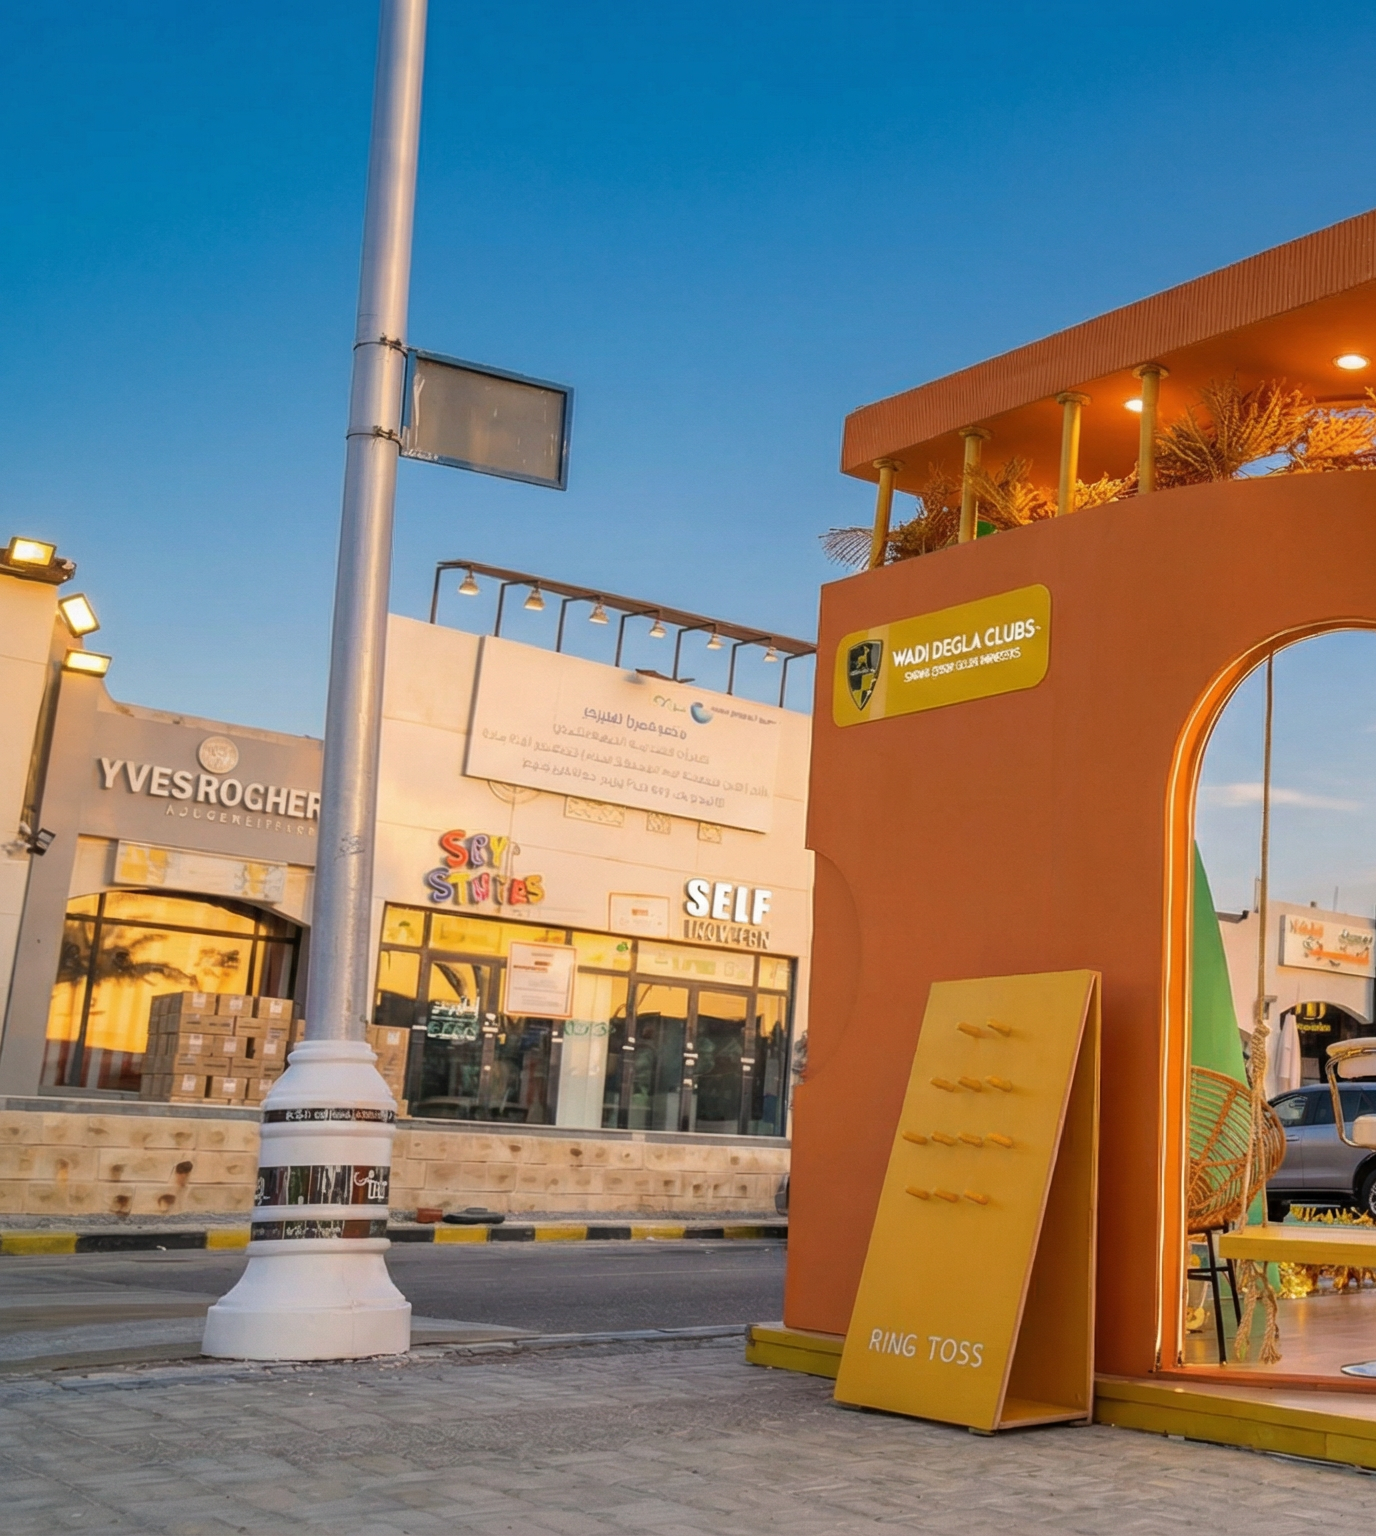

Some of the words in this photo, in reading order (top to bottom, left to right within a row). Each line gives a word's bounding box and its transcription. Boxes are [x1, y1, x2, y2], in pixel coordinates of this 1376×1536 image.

[892, 642, 929, 667] WADI
[932, 632, 982, 660] DEGLA
[101, 757, 194, 800] YVES
[685, 878, 773, 925] SELF
[868, 1328, 918, 1358] RING
[928, 1335, 984, 1368] TOSS
